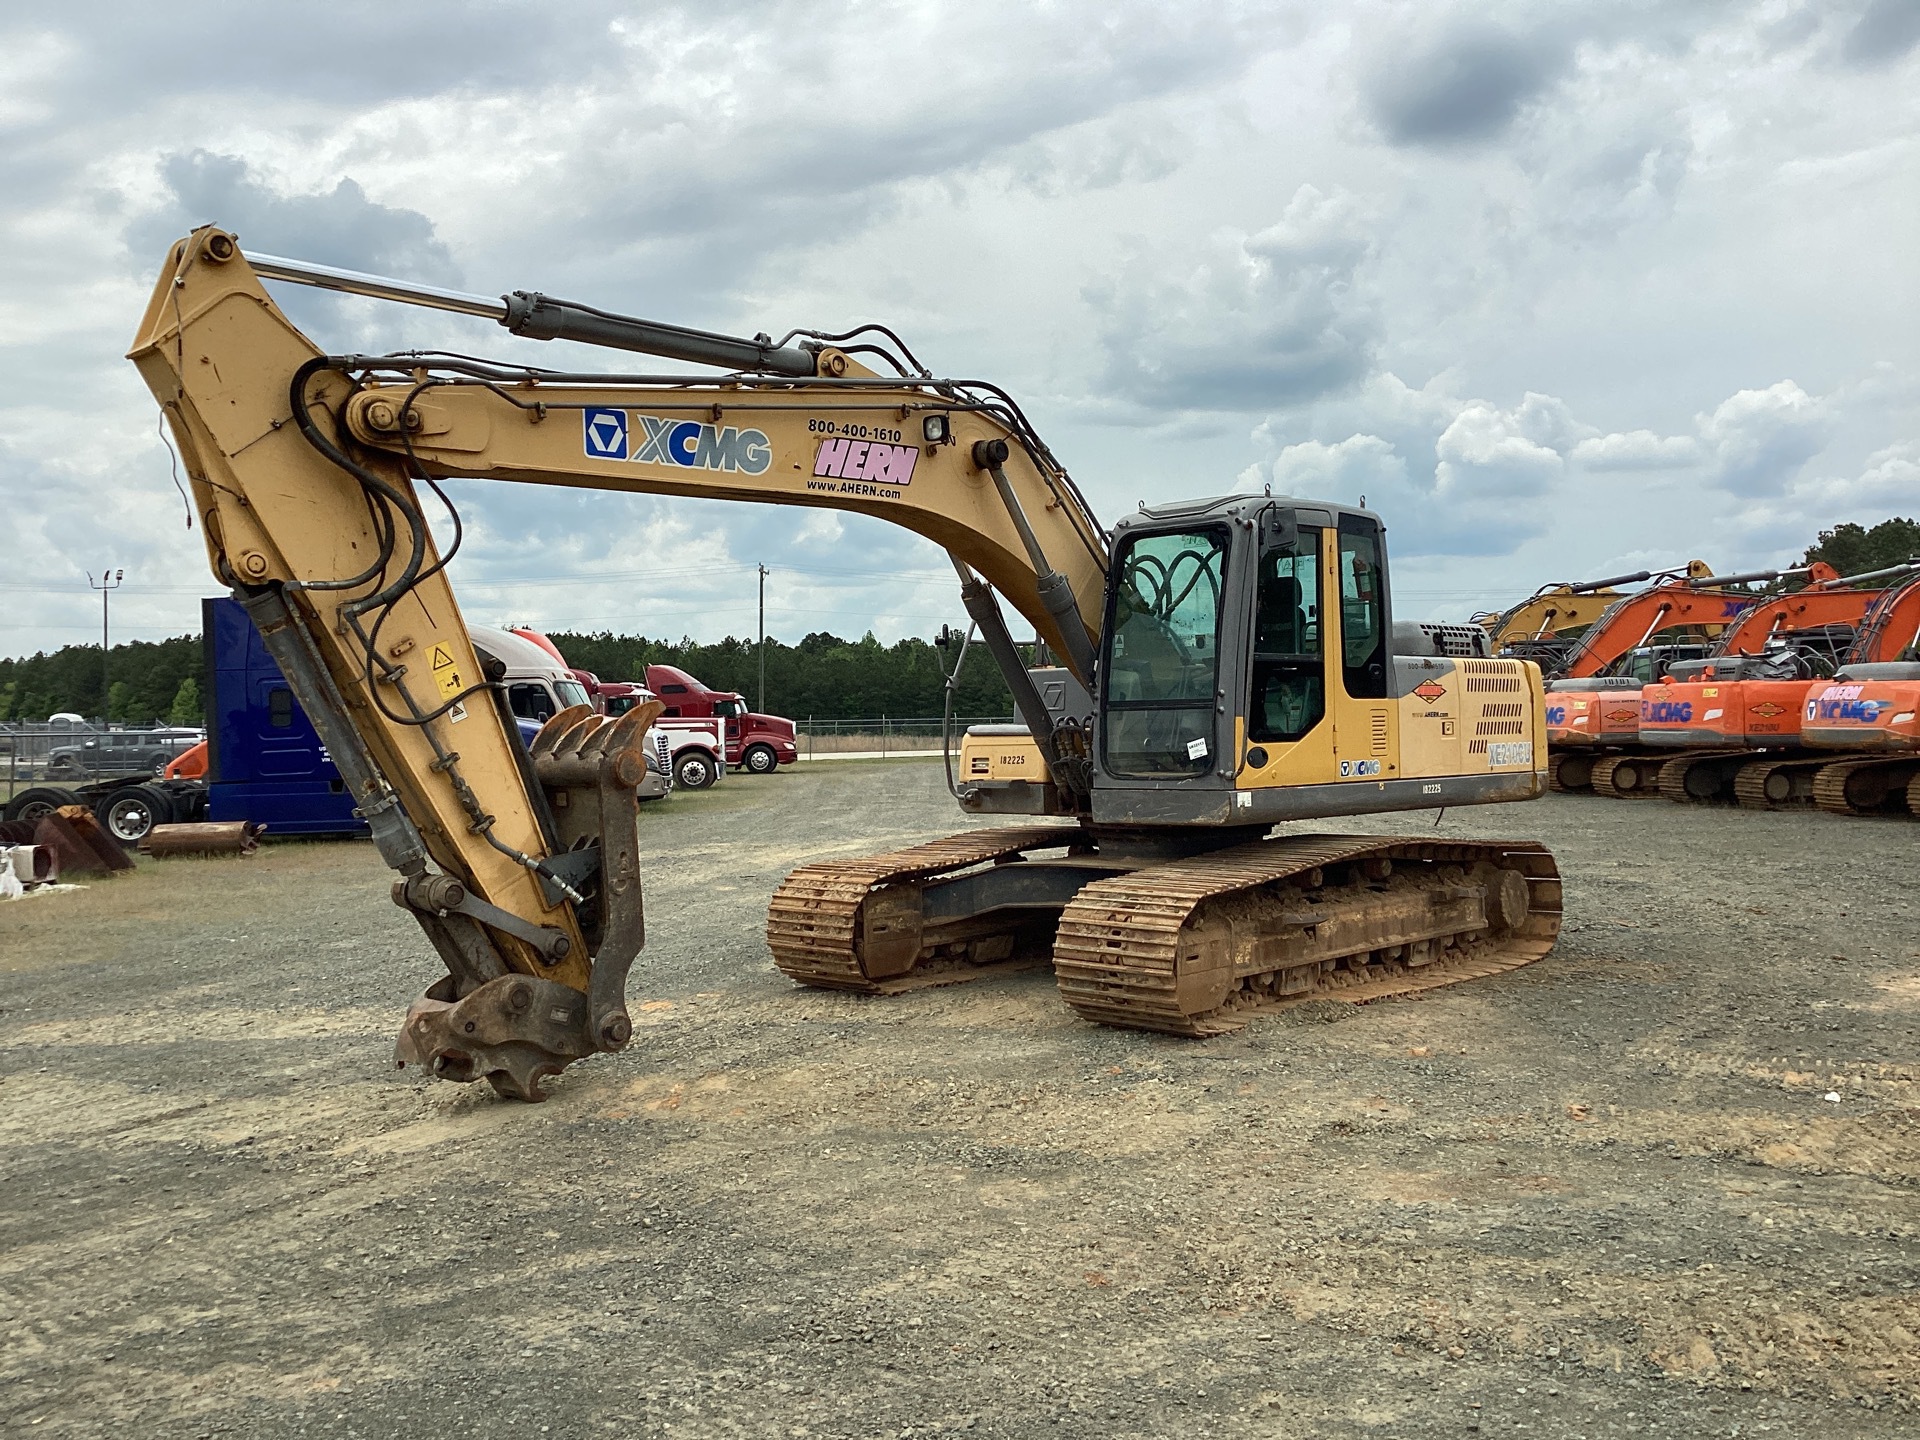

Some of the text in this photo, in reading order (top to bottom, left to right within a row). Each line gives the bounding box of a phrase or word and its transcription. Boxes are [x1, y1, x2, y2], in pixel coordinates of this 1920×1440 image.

[808, 419, 901, 442] 800-400-1610
[629, 414, 772, 475] XCMG
[807, 480, 901, 499] www.AHERN.com
[1651, 701, 1694, 723] XCMG
[999, 755, 1026, 765] 182225
[1350, 759, 1381, 776] XCMG
[1422, 783, 1442, 794] 182225
